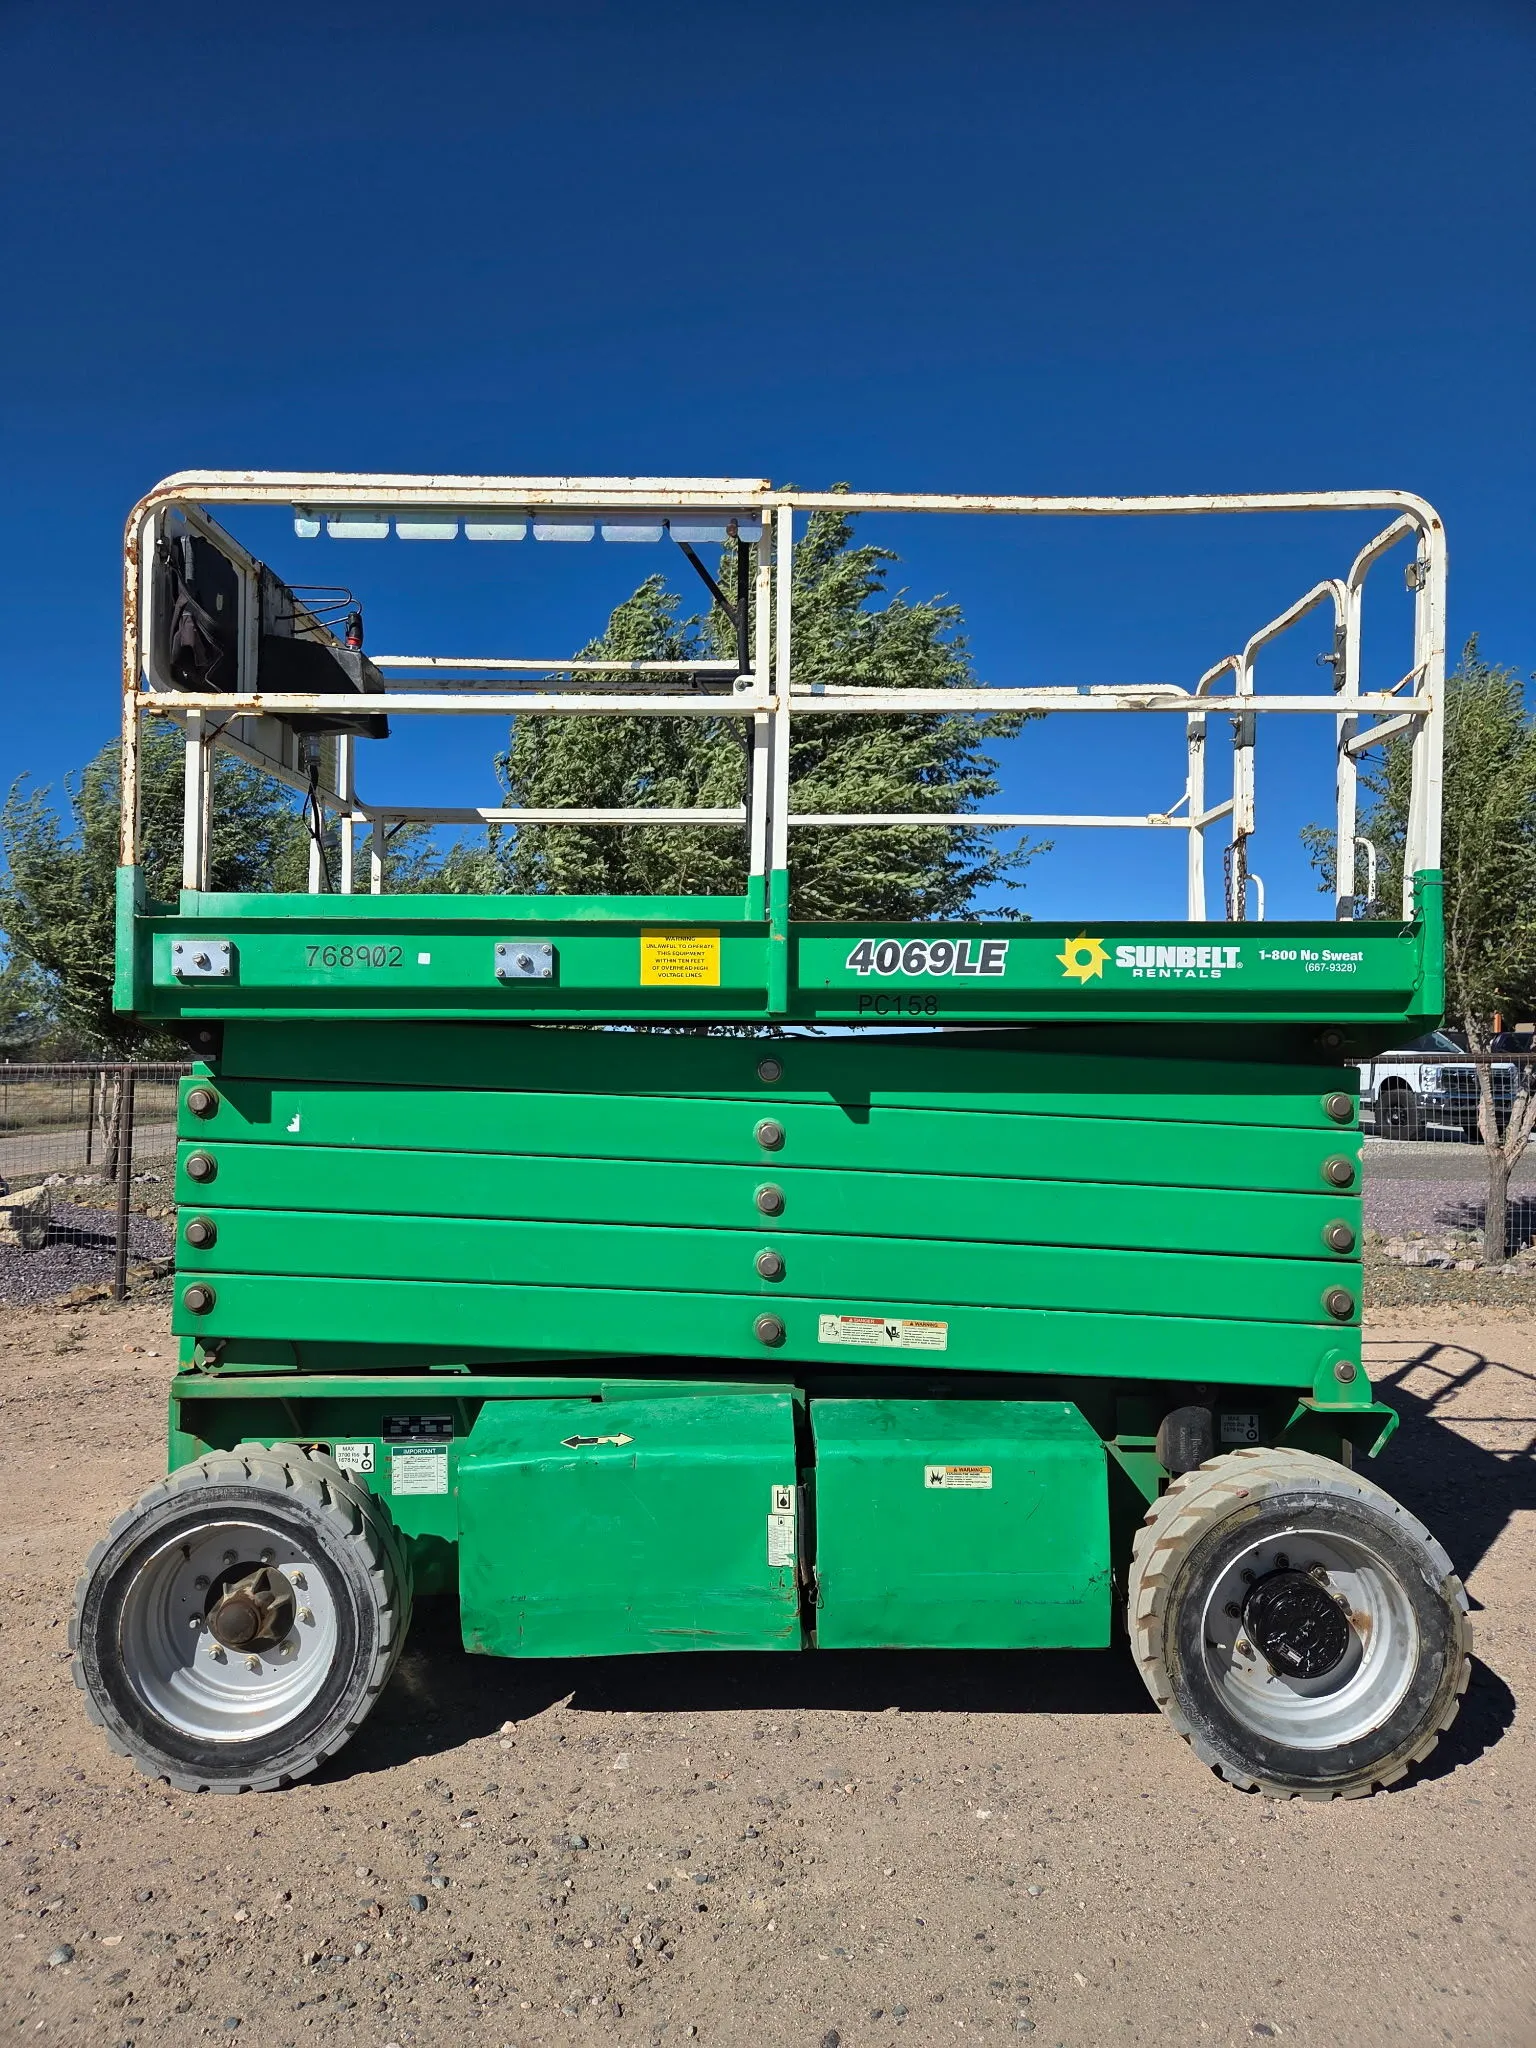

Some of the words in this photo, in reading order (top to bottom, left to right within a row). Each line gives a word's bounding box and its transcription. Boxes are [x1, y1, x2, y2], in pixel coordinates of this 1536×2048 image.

[305, 945, 403, 968] 768902
[845, 939, 1010, 976] 4069LE
[1258, 949, 1298, 960] 1-800
[1300, 949, 1319, 960] No
[1321, 949, 1364, 961] Sweat
[1132, 968, 1222, 979] RENTALS
[1305, 962, 1357, 974] (667-9328)
[858, 994, 939, 1016] PC158
